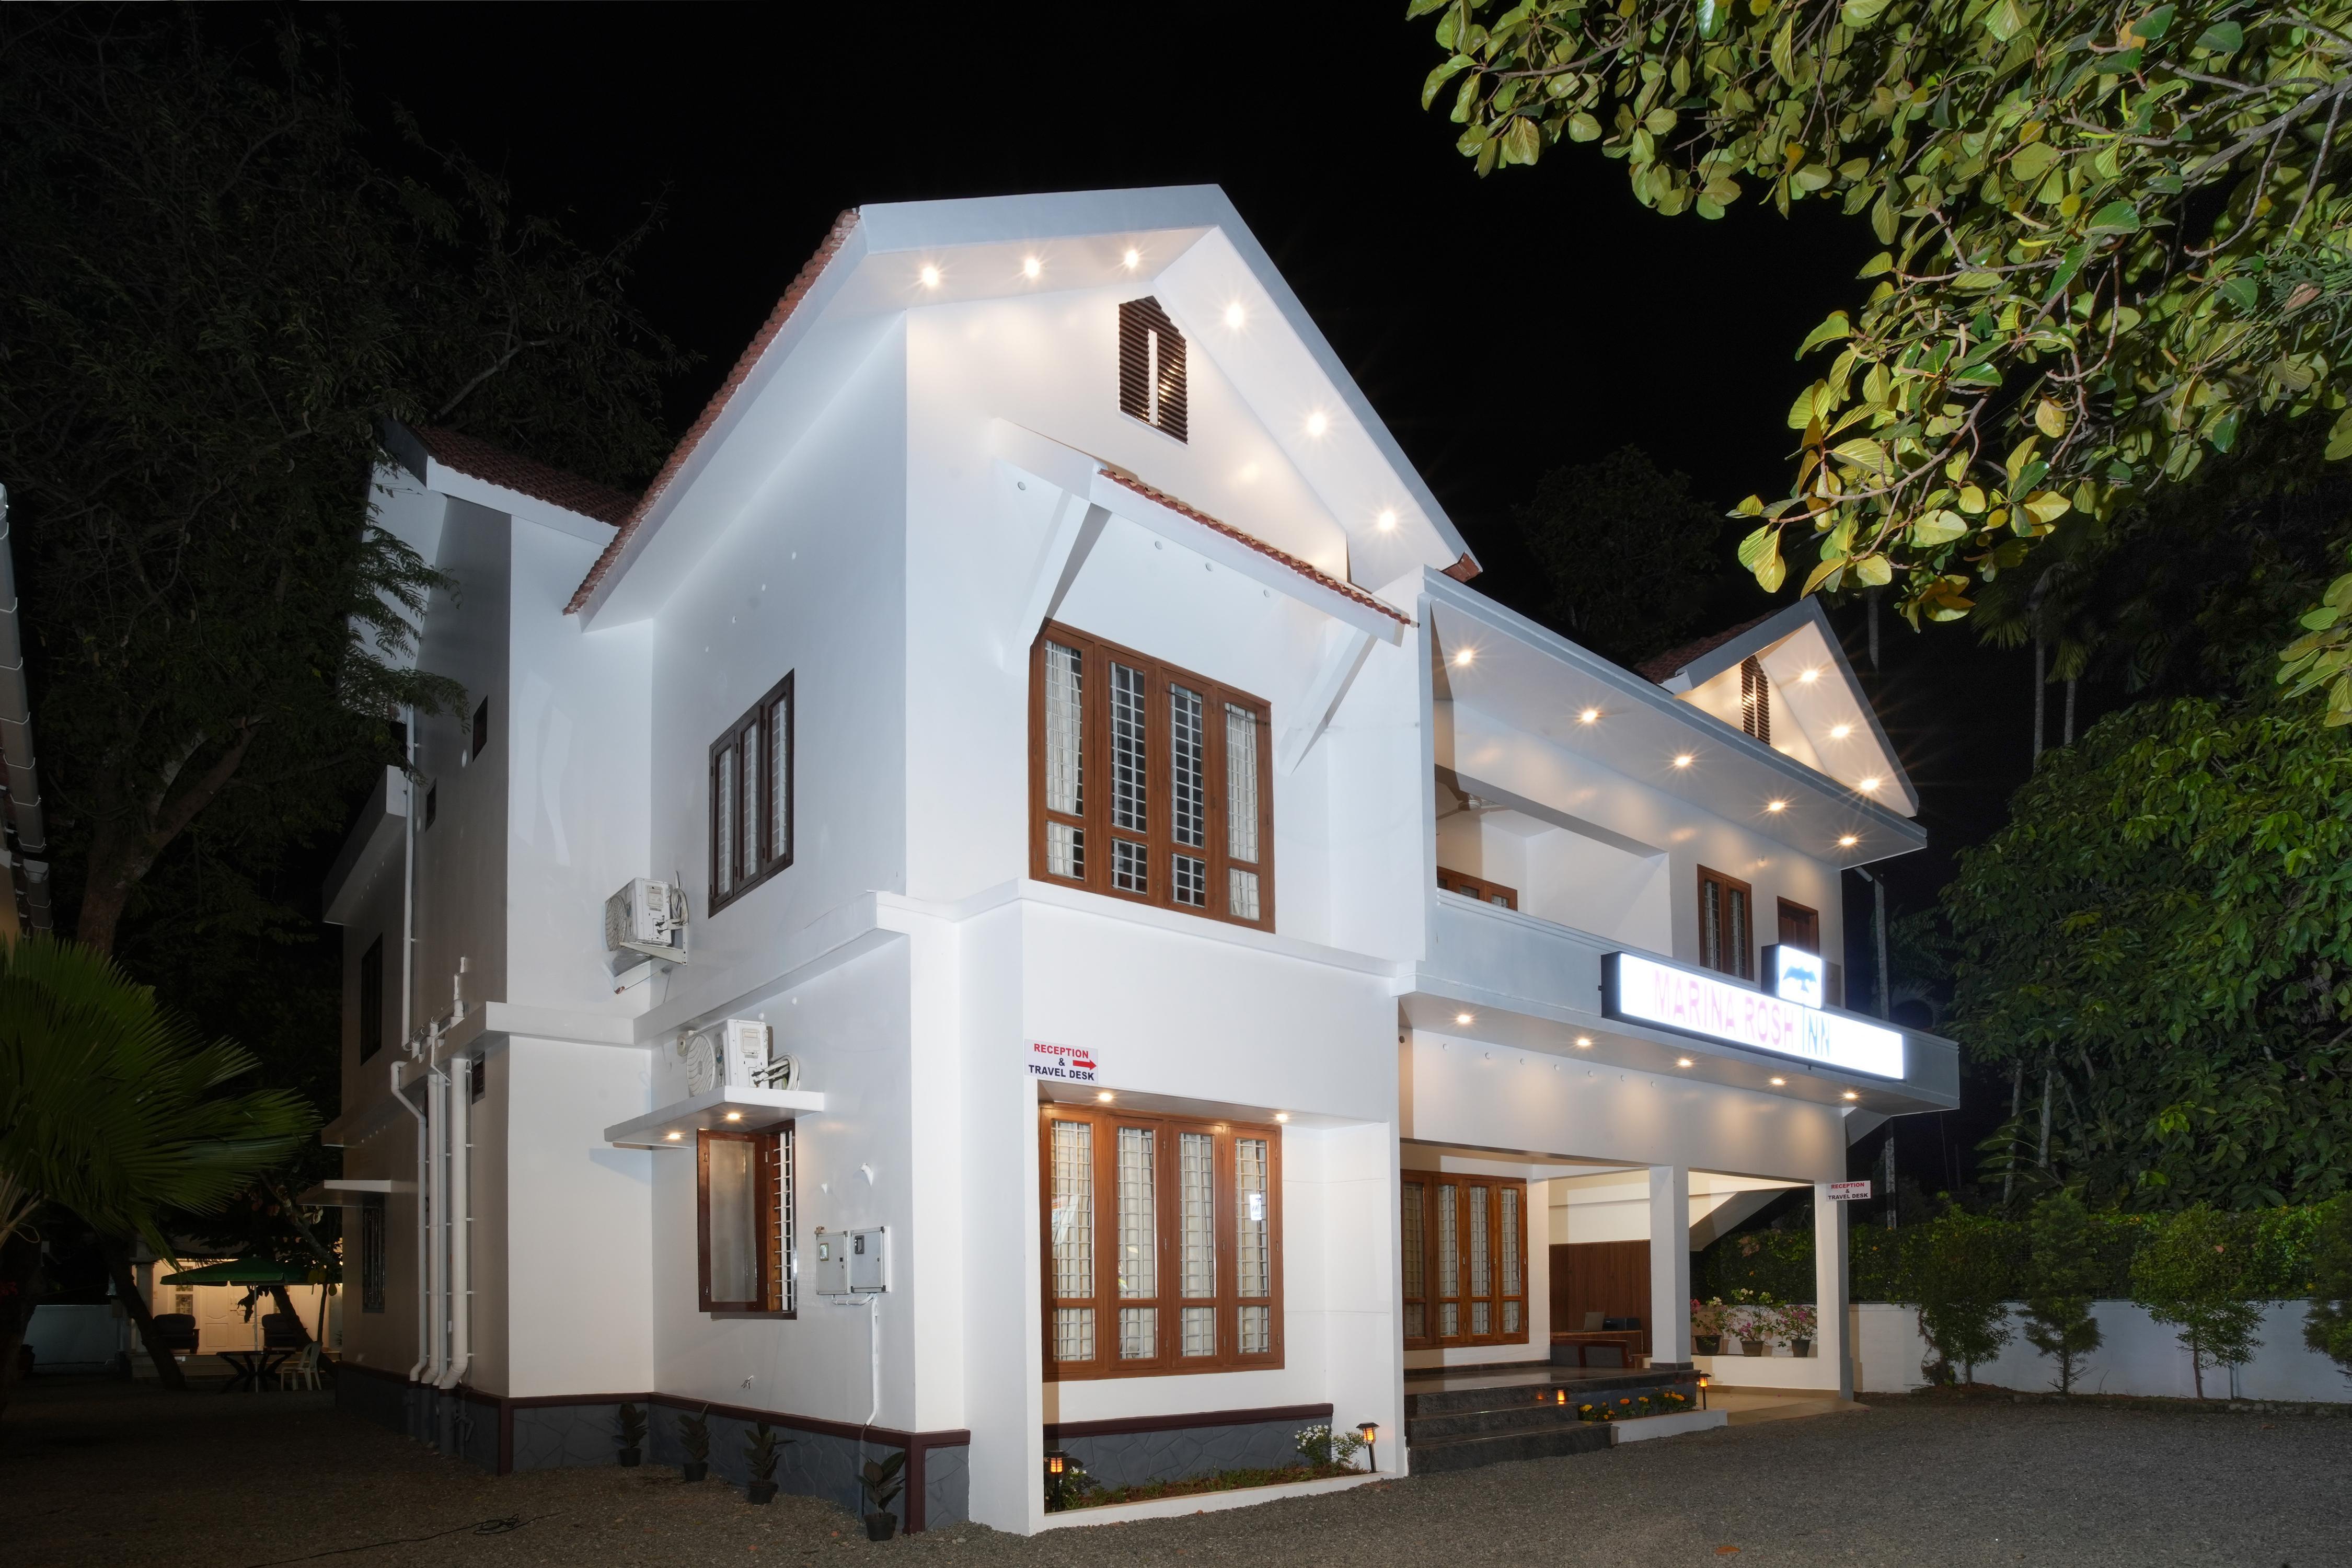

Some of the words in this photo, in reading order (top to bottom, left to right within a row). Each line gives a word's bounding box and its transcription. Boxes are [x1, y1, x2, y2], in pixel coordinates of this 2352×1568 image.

[1655, 970, 1736, 1035] MARINA
[1745, 995, 1794, 1050] ROSH
[1802, 1005, 1830, 1057] INN
[1034, 1043, 1089, 1059] RECEPTION
[1058, 1057, 1065, 1066] &
[1029, 1065, 1066, 1077] TRAVEL
[1069, 1070, 1094, 1081] DESK
